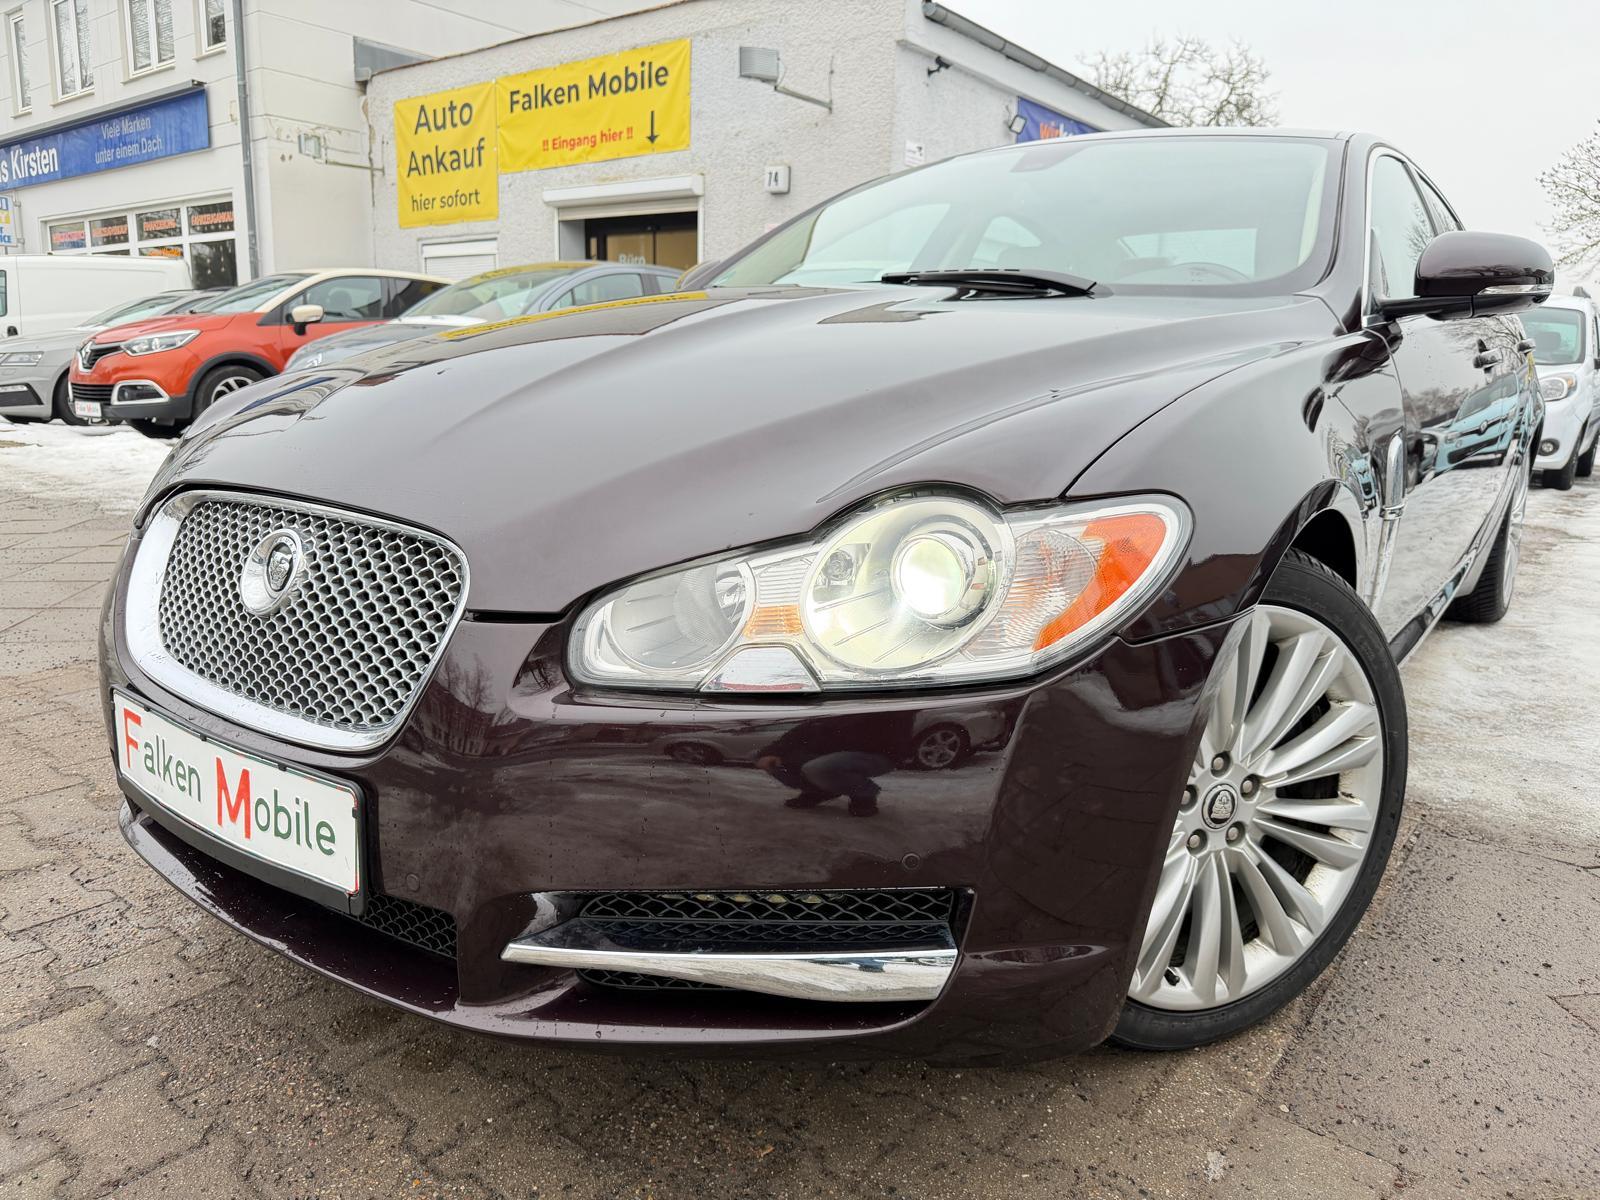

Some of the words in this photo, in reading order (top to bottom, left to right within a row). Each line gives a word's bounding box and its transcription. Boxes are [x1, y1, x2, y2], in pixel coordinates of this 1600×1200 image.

[509, 82, 580, 114] Falken
[588, 60, 669, 100] Mobile
[101, 122, 120, 140] Viele
[122, 116, 151, 135] Marken
[414, 100, 473, 135] Auto
[95, 147, 114, 164] unter
[116, 142, 140, 159] einem
[552, 130, 597, 151] Eingang
[600, 127, 624, 145] hier
[11, 145, 58, 180] Kirsten
[407, 137, 486, 178] Ankauf
[411, 193, 436, 212] hier
[440, 188, 481, 208] sofort
[618, 252, 646, 265] Büro
[123, 707, 202, 803] Falken
[216, 756, 336, 856] Mobile
